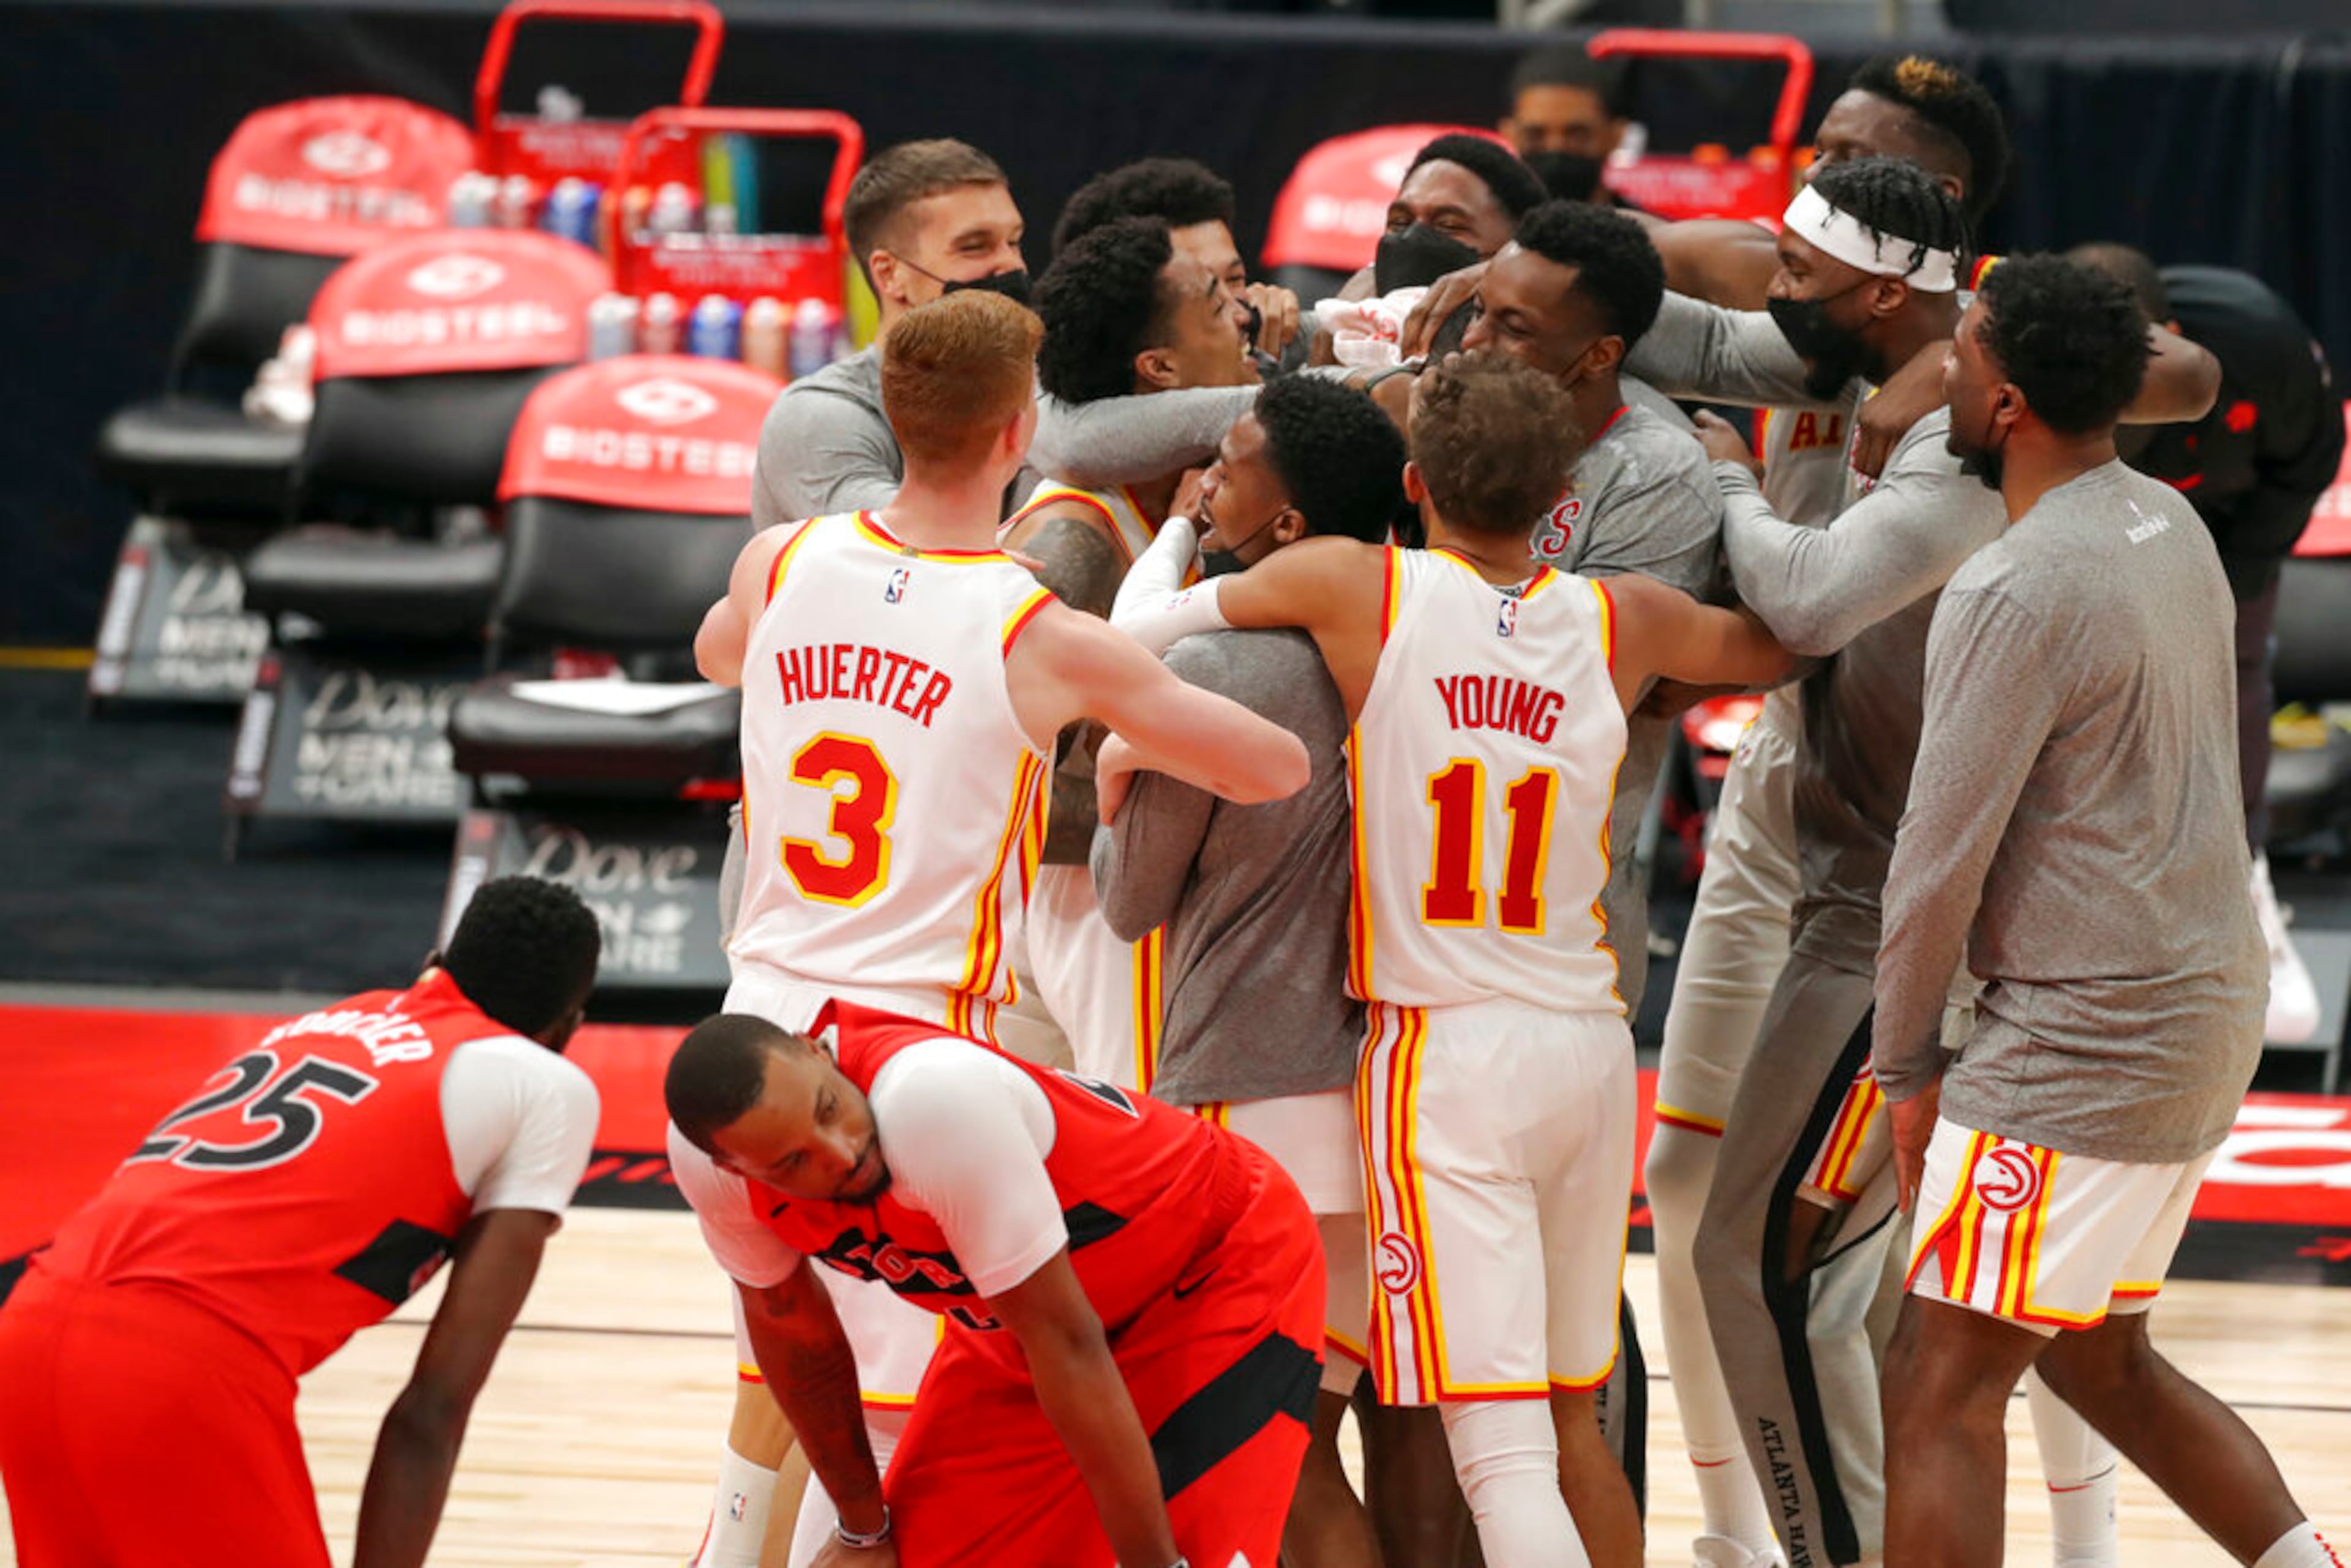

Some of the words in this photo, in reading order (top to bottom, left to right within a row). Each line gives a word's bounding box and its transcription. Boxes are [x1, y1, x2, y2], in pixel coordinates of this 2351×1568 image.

[776, 644, 953, 728] HUERTER
[1434, 675, 1565, 745] YOUNG
[779, 730, 899, 909] 3
[1421, 757, 1559, 936] 11
[122, 1049, 380, 1172] 25
[1758, 1416, 1801, 1520] ATLANTA
